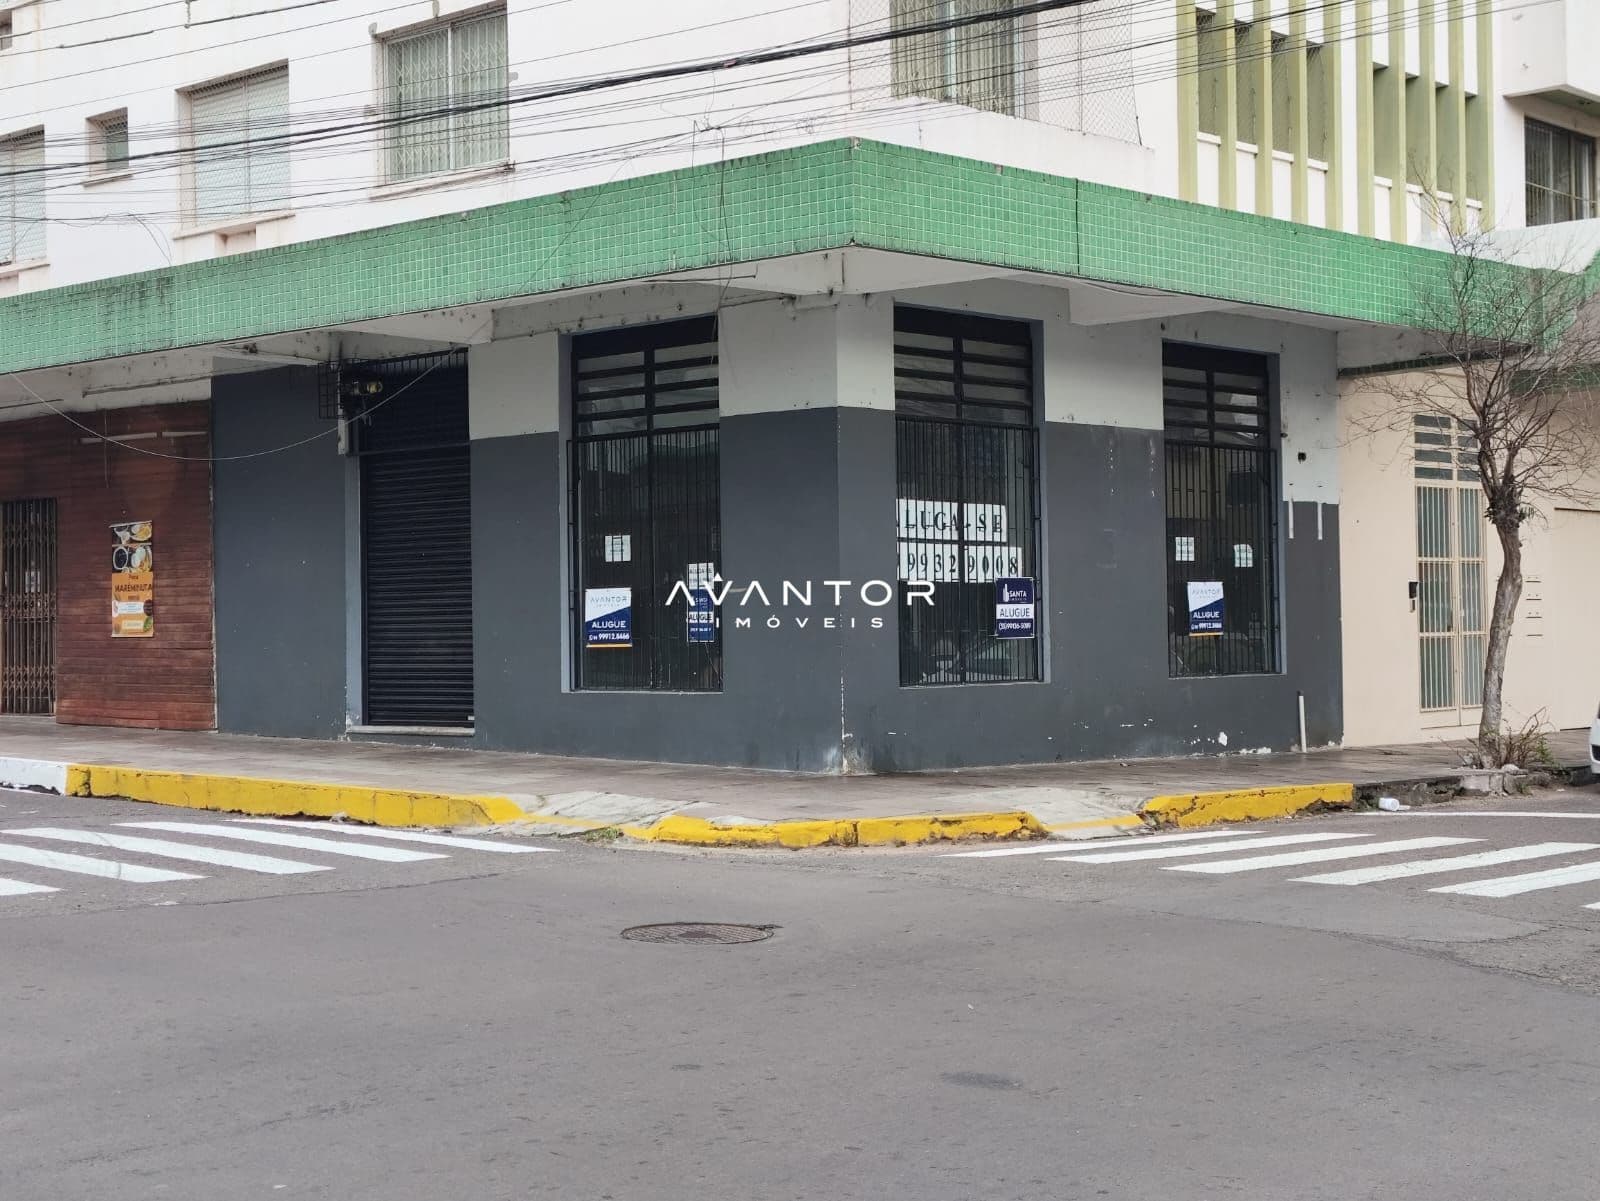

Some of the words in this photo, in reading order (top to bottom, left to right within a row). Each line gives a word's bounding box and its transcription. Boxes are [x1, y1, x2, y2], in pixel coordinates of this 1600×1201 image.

[897, 509, 1002, 533] LUGA-SE
[897, 553, 1019, 575] 99329008
[1009, 590, 1027, 598] SANTA
[999, 607, 1031, 618] ALUGUE
[1193, 611, 1220, 619] ALUGUE
[591, 620, 626, 629] ALUGUE
